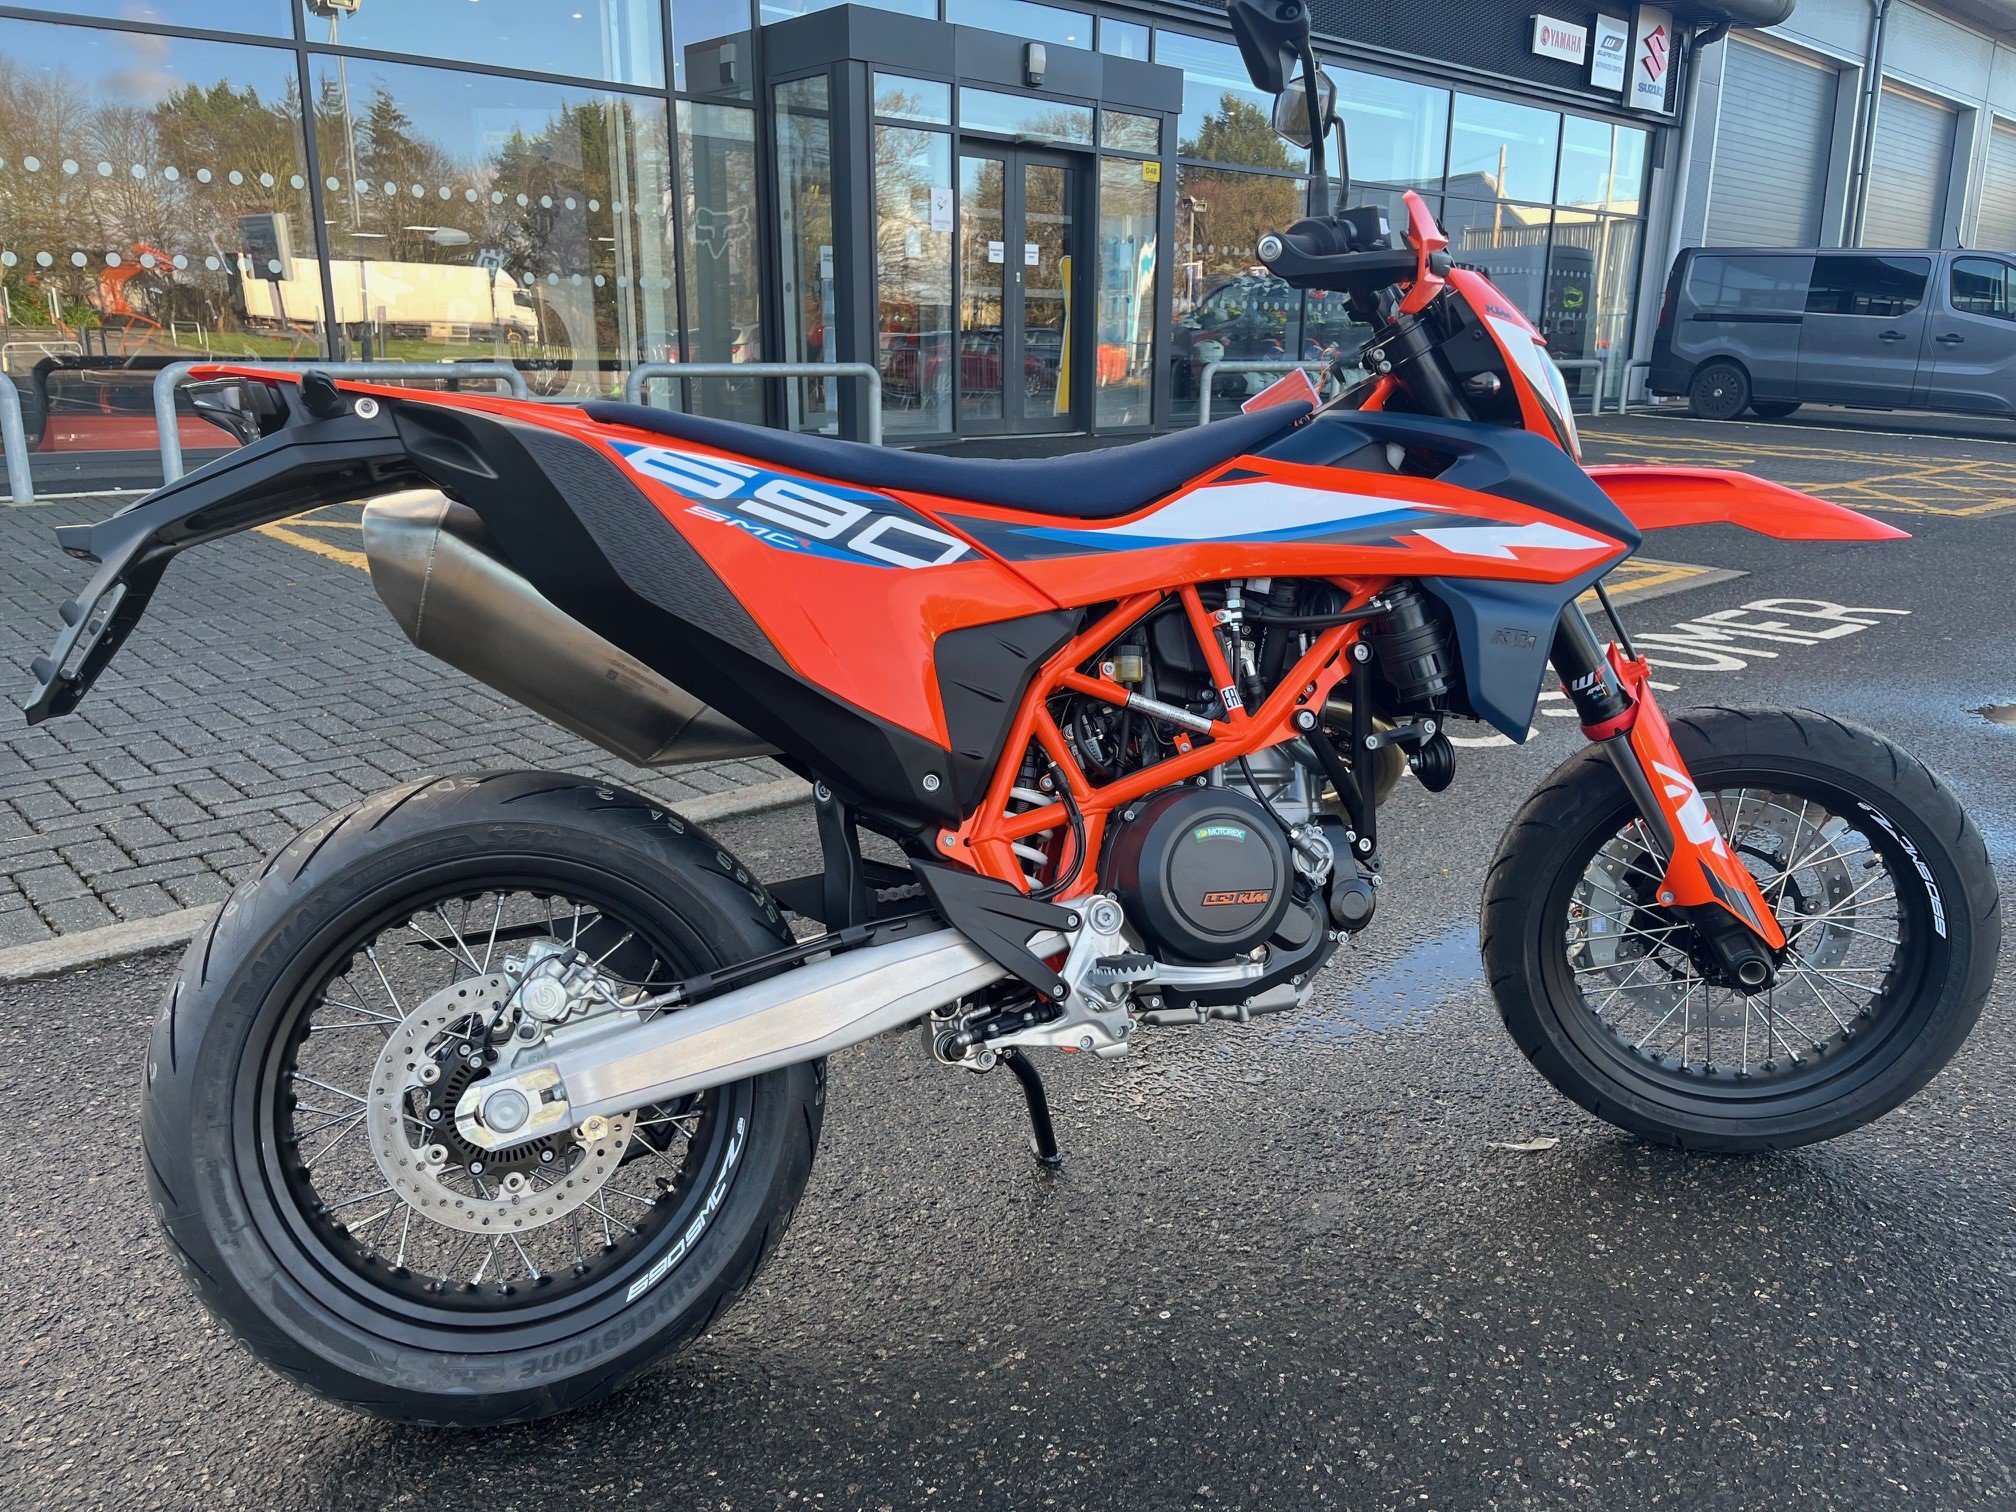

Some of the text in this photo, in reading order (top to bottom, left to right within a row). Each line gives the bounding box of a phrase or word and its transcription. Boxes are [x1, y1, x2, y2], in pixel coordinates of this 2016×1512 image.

[1550, 29, 1581, 53] YAMAHA
[624, 446, 971, 569] 690
[1490, 627, 1537, 649] KTM
[1571, 664, 1607, 692] WP
[1586, 682, 1606, 697] APEX
[1207, 827, 1243, 838] MOTOREX
[1237, 890, 1269, 904] KTM
[517, 1245, 721, 1380] BRIDGESTONE
